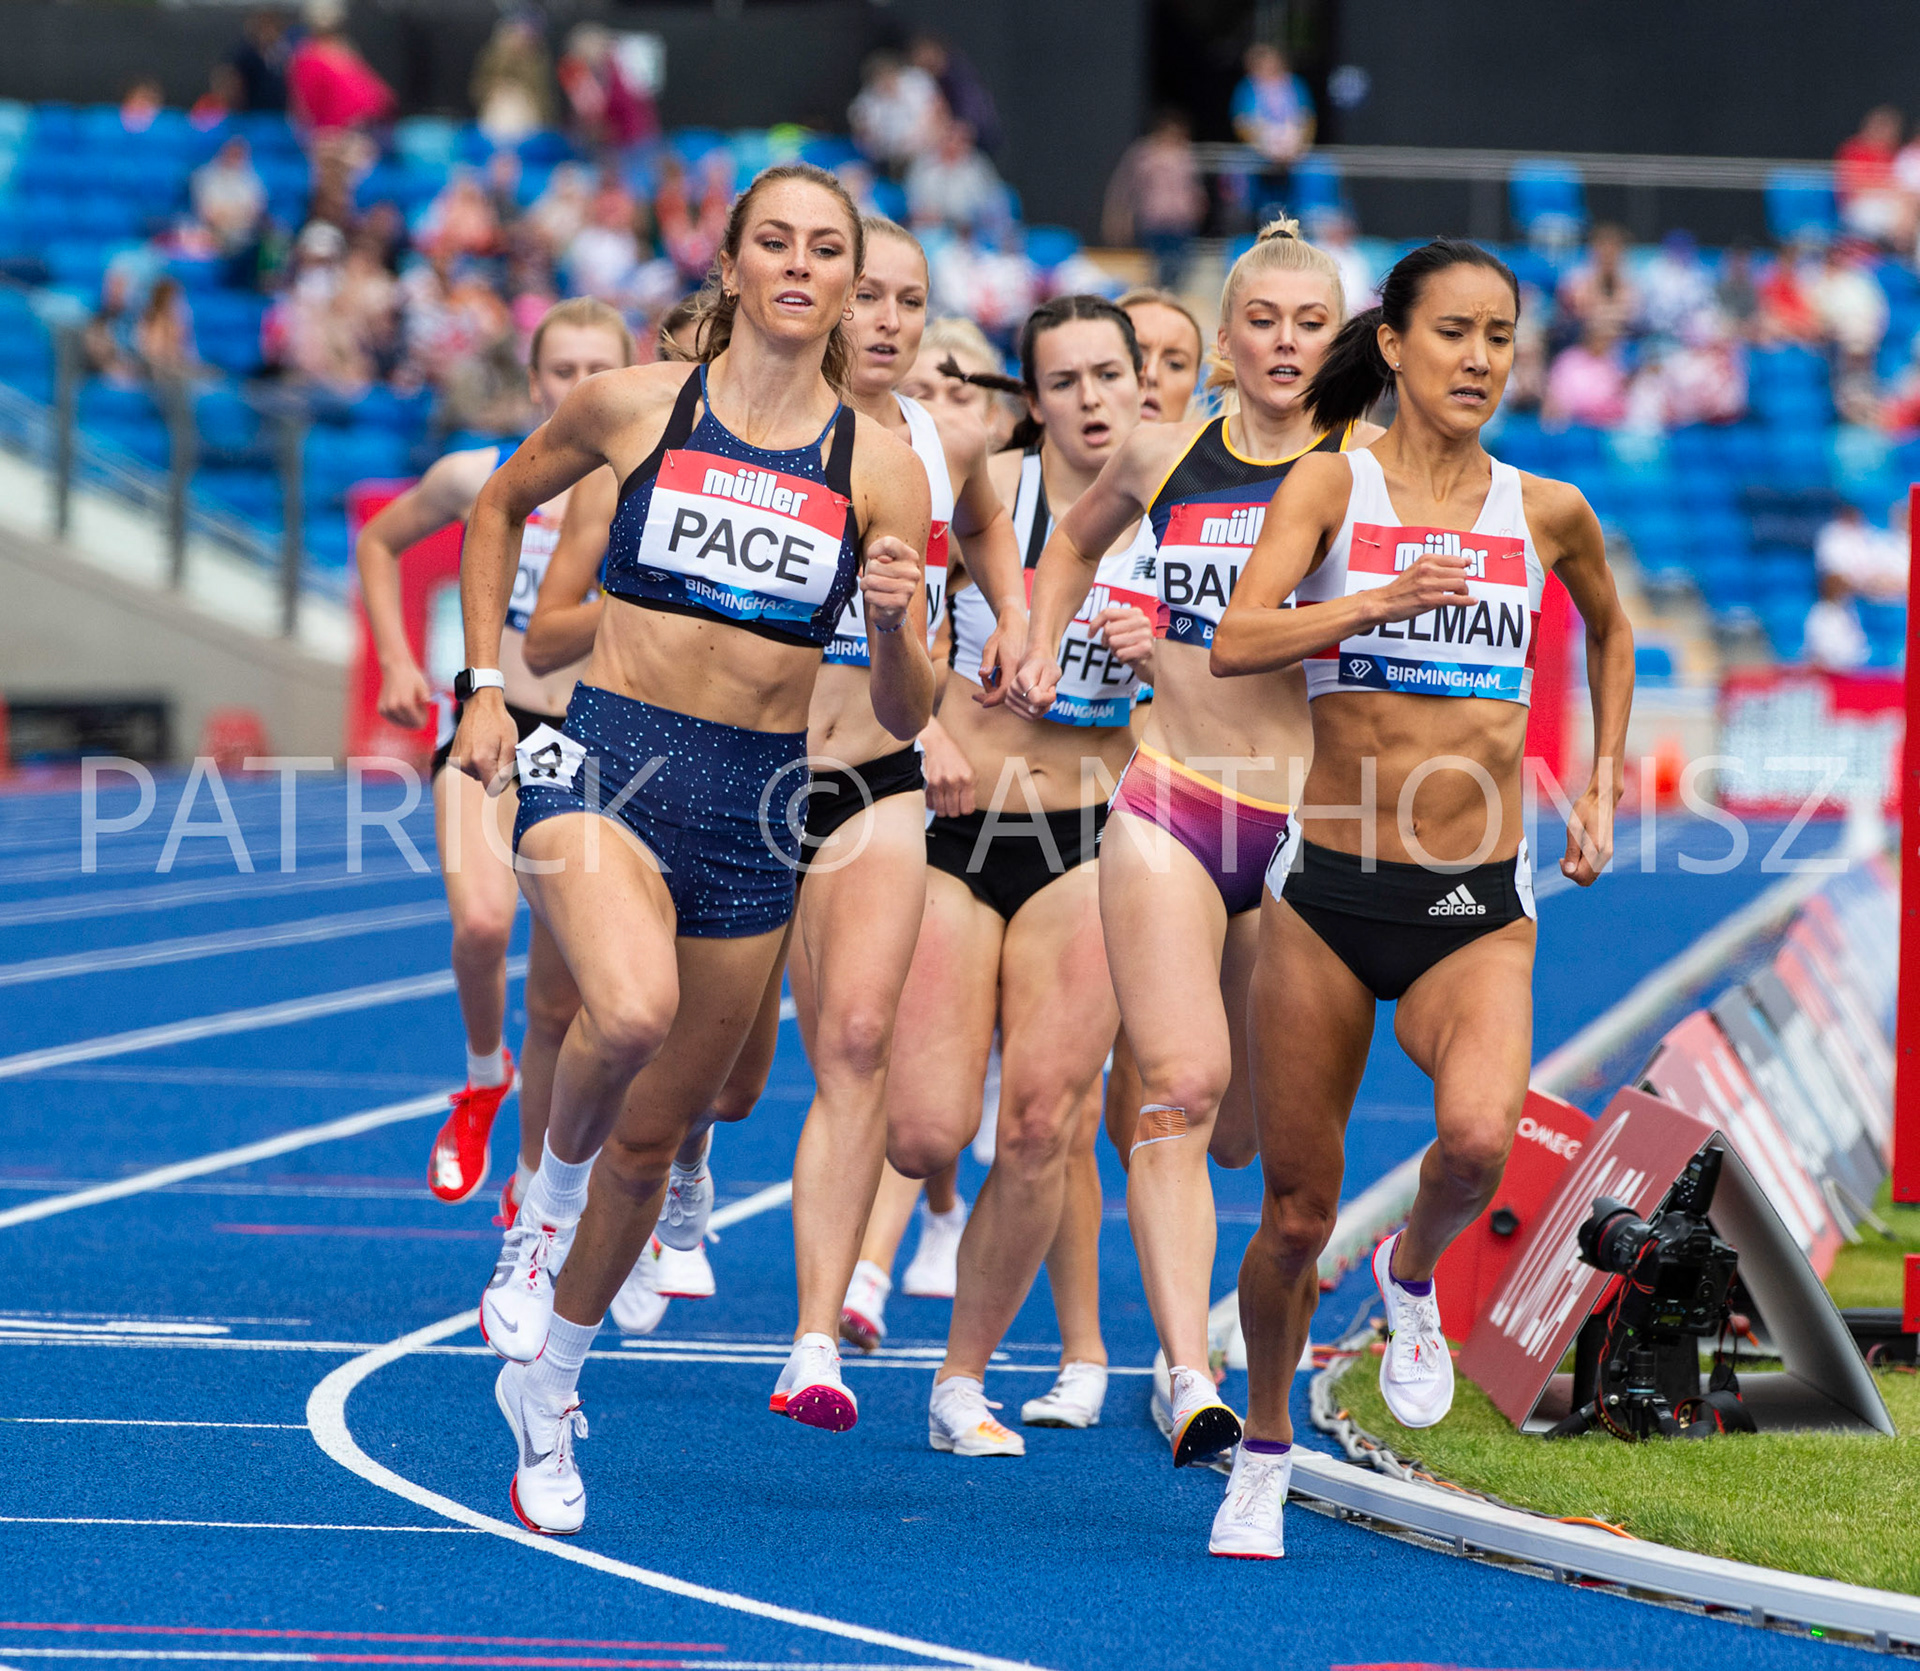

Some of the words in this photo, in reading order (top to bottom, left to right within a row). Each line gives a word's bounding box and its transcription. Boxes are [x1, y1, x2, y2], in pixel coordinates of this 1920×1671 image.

[701, 467, 808, 517] müller
[668, 507, 815, 585] PACE
[1385, 664, 1501, 689] BIRMINGHAM
[1428, 903, 1487, 916] adidas
